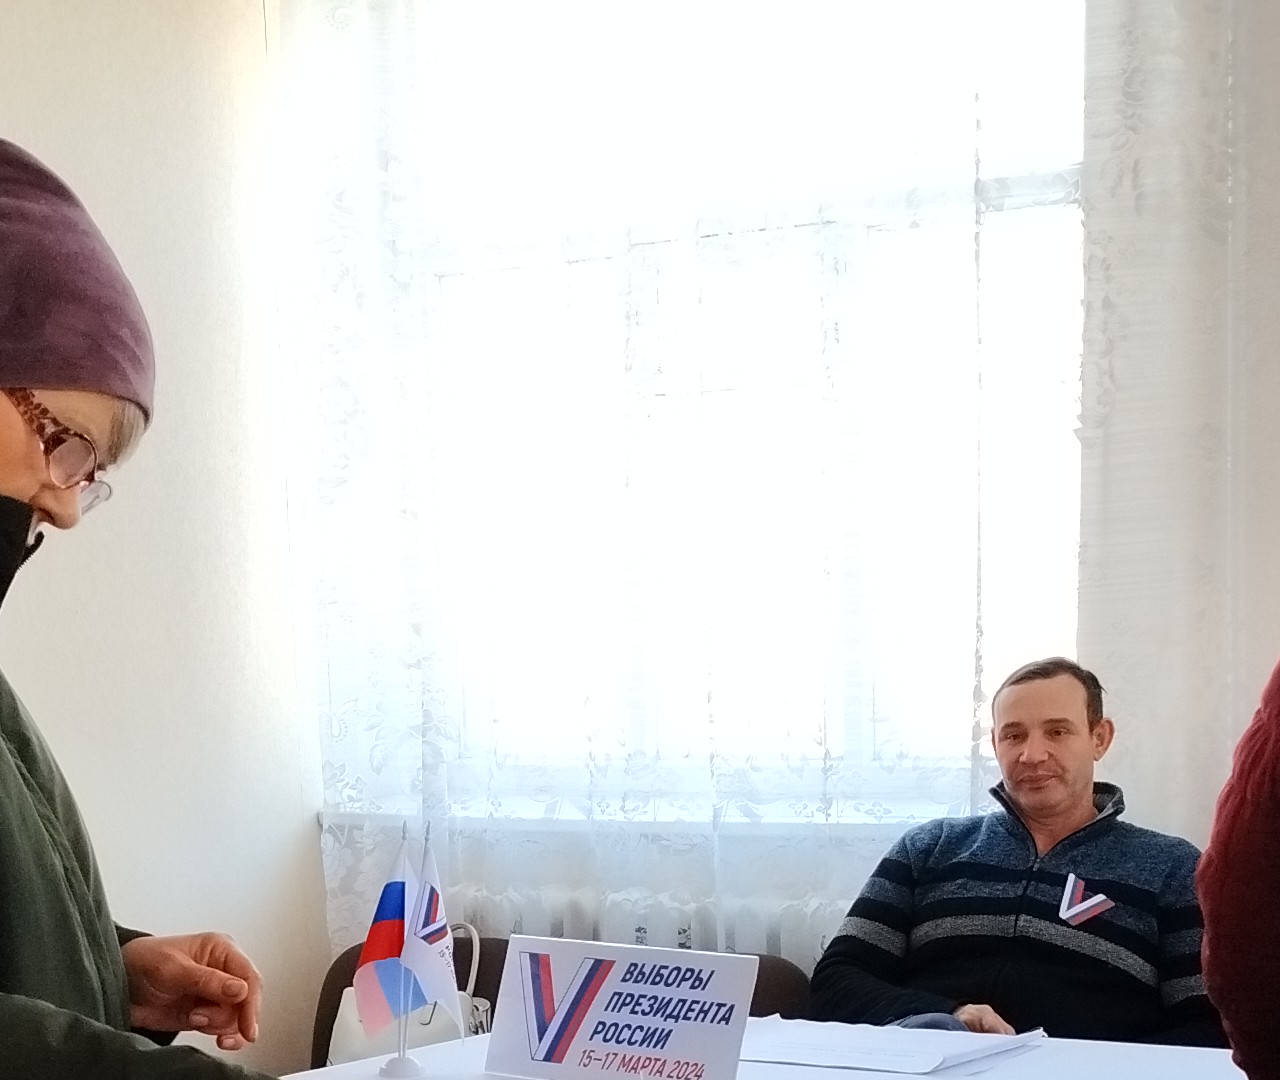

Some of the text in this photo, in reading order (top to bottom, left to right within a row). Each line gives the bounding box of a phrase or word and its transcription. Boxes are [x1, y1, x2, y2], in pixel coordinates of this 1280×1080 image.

[620, 962, 715, 991] ВЫБОРЫ
[604, 991, 736, 1025] ПРЕЗИДЕНТА
[589, 1020, 673, 1050] РОССИИ
[617, 1054, 667, 1078] МАРТА
